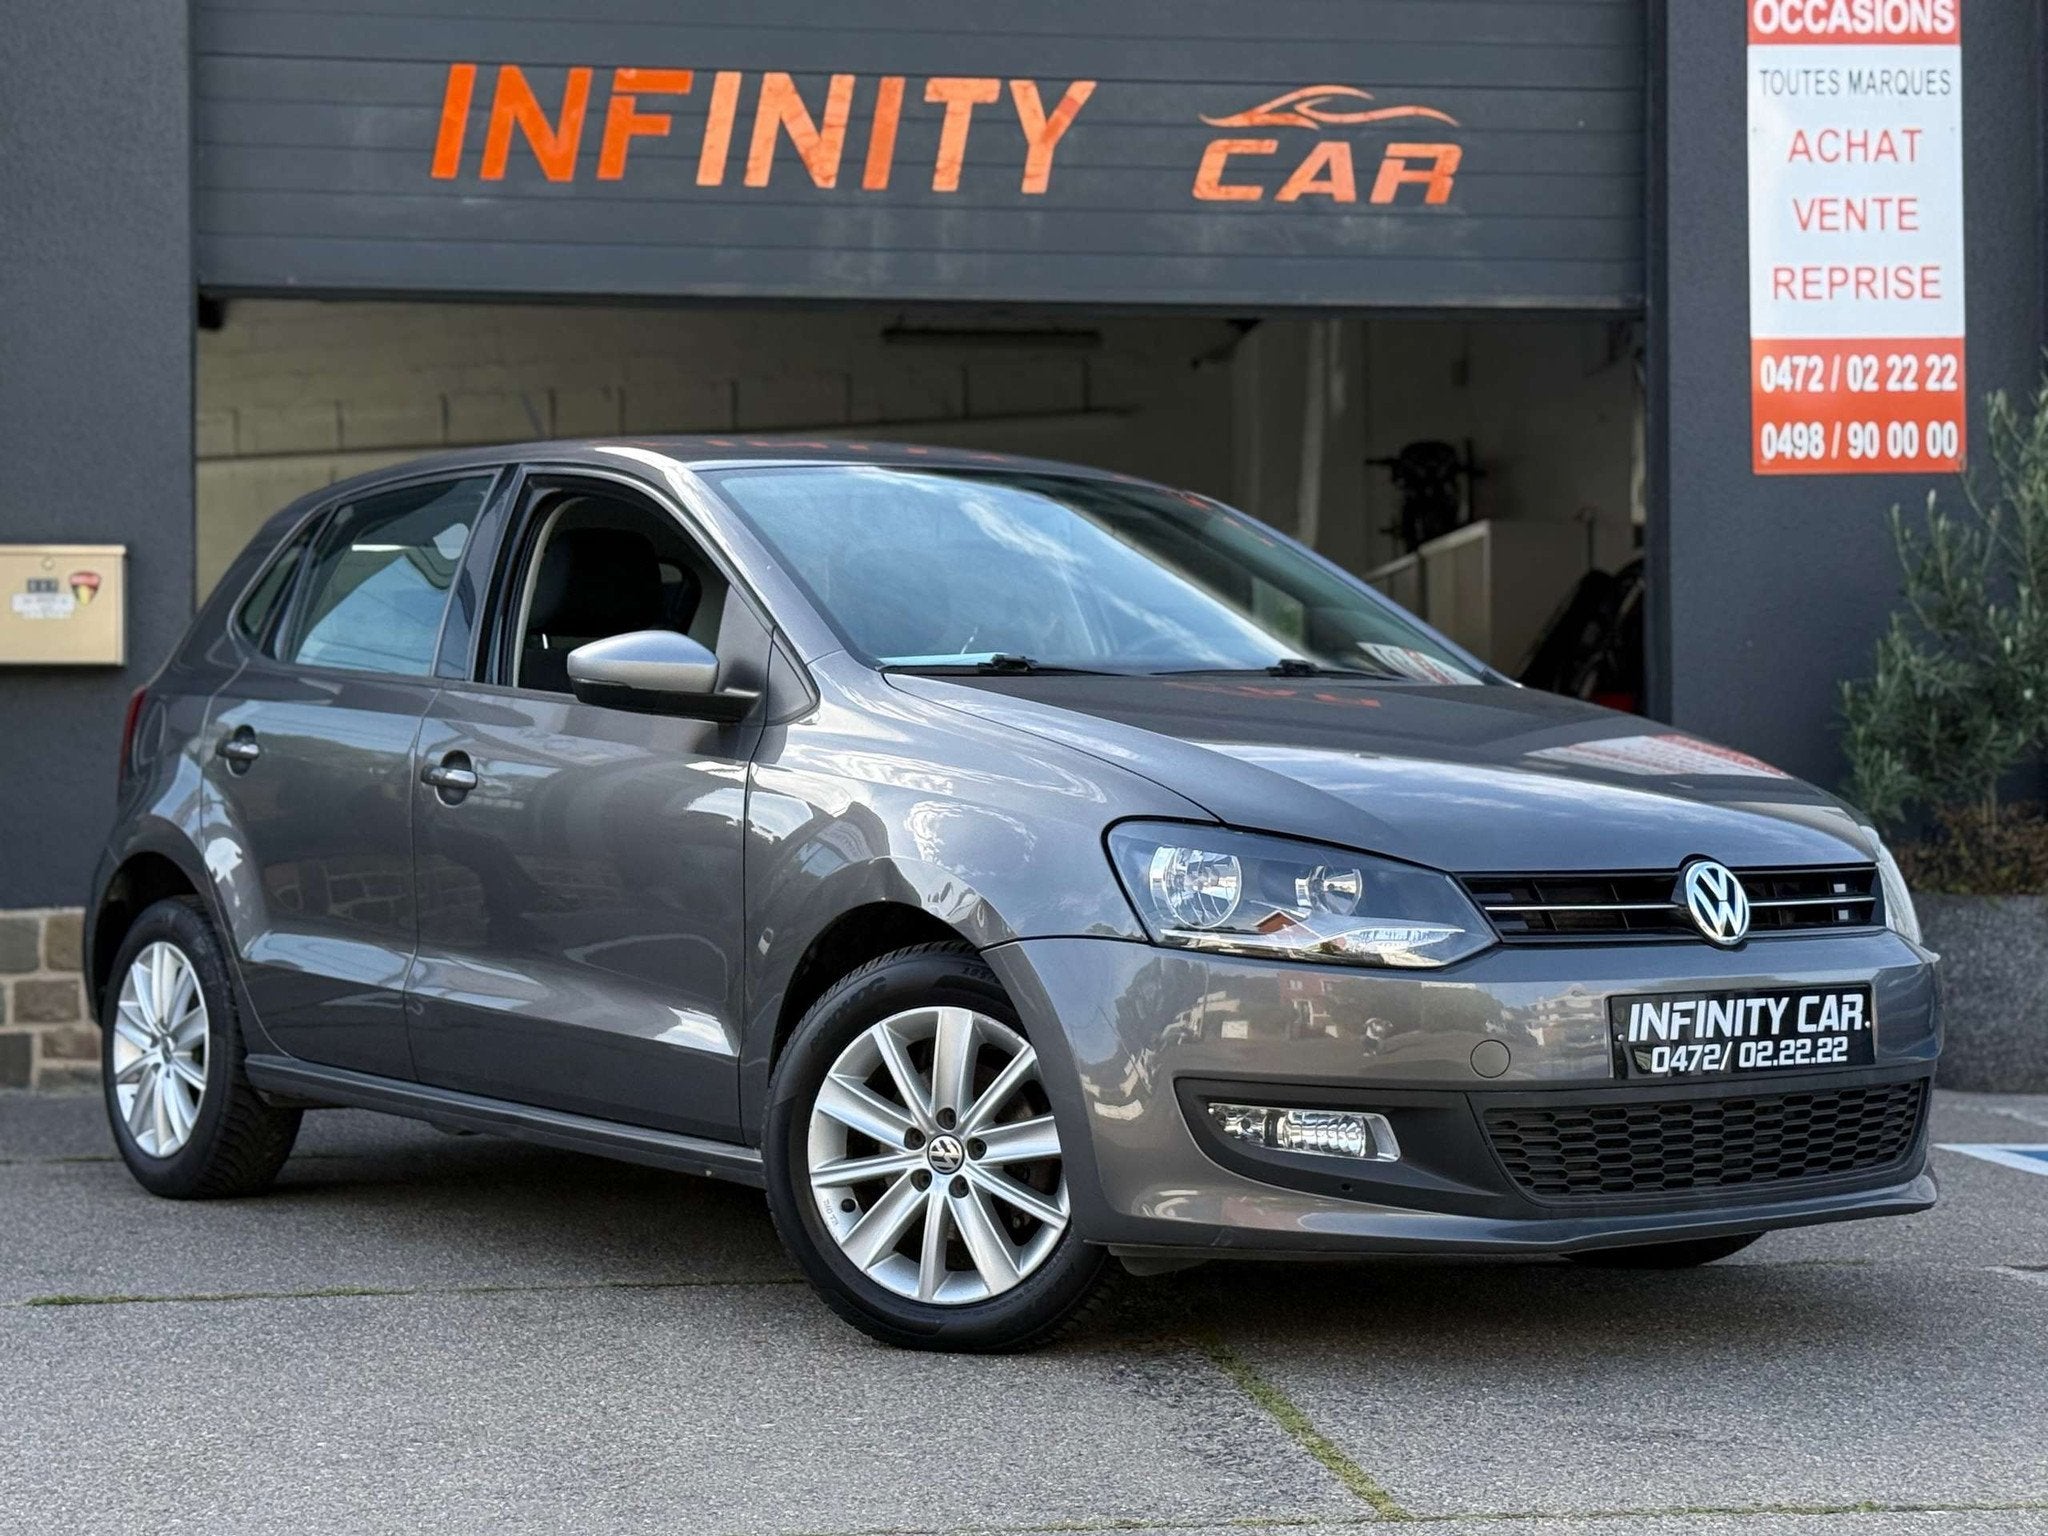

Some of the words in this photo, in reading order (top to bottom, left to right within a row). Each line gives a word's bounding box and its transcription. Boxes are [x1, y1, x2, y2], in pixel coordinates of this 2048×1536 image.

[1752, 0, 1956, 35] OCCASIONS
[1759, 69, 1841, 96] TOUTES
[1849, 69, 1952, 96] MARQUES
[430, 63, 1097, 194] INFINITY
[1192, 138, 1464, 205] CAR
[1788, 128, 1923, 163] ACHAT
[1792, 198, 1920, 232] VENTE
[1772, 265, 1942, 301] REPRISE
[1760, 354, 1825, 394] 0472
[1885, 353, 1920, 392] 22
[1924, 352, 1959, 392] 22
[1760, 421, 1826, 461] 0498
[1886, 420, 1920, 460] 00
[1925, 420, 1959, 459] 00
[1627, 996, 1791, 1043] INFINITY
[1796, 993, 1865, 1034] CAR
[1651, 1040, 1734, 1075] 0472/
[1738, 1035, 1849, 1070] 02.22.22
